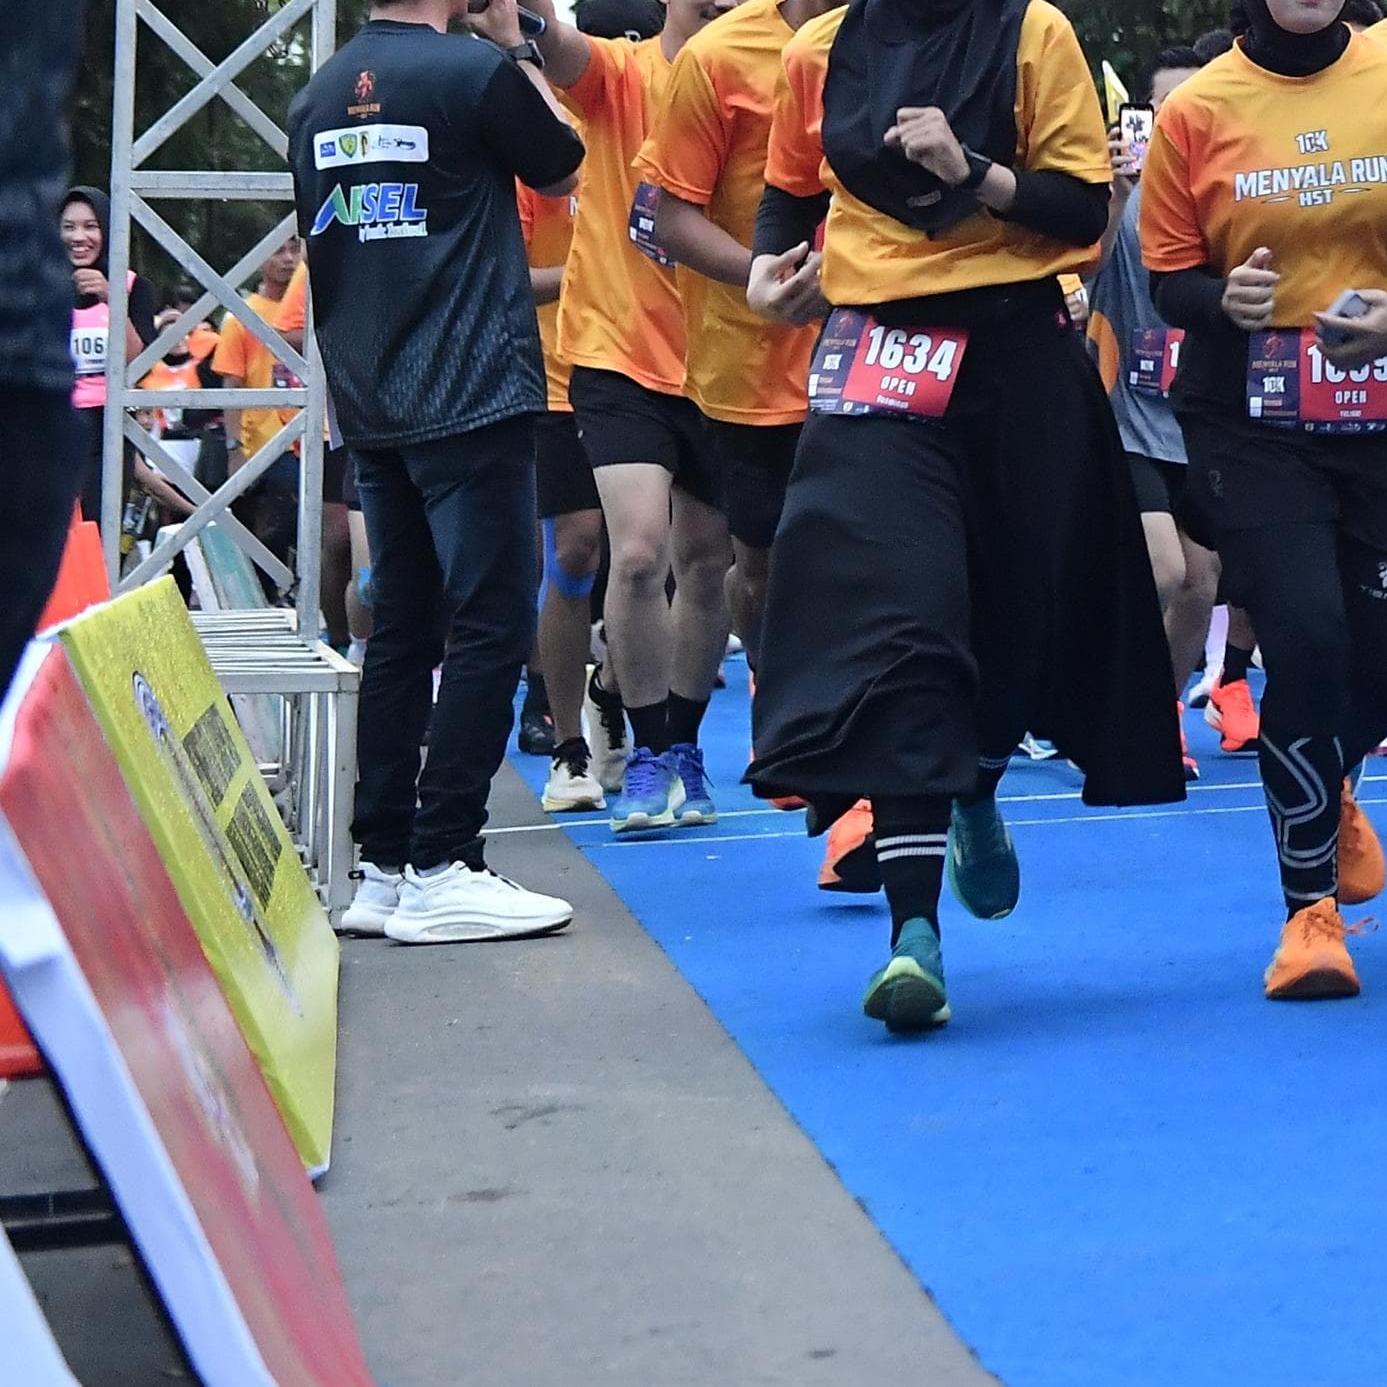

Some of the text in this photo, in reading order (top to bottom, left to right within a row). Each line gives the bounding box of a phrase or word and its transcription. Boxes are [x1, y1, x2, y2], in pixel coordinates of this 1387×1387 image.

[1296, 129, 1329, 154] 10K
[1234, 161, 1346, 201] MENYALA
[1299, 189, 1333, 207] HST
[864, 325, 957, 381] 1634
[880, 375, 916, 395] OPEN
[1335, 390, 1366, 404] OPEN
